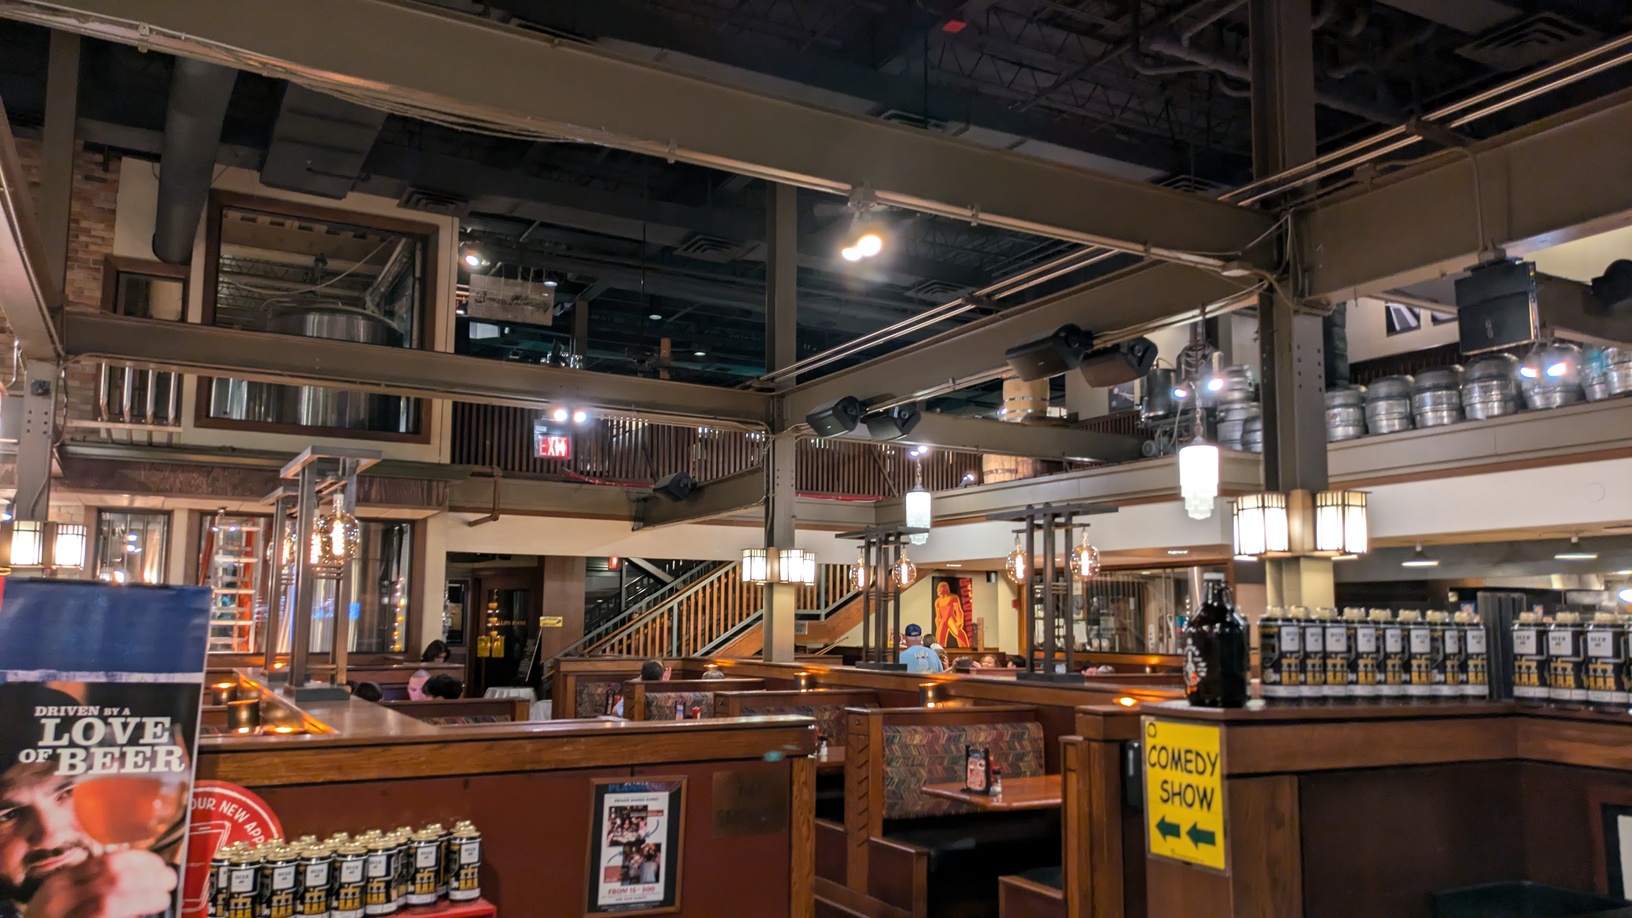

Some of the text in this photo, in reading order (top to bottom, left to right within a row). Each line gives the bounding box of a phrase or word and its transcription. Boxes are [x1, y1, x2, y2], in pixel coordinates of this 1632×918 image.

[538, 436, 567, 457] EXIT
[34, 706, 131, 716] DRIVEN BY A
[38, 717, 171, 746] LOVE
[18, 746, 186, 776] OF BEER
[1148, 745, 1219, 777] COMEDY
[1160, 779, 1215, 812] SHOW
[219, 800, 251, 823] NEW
[243, 821, 265, 845] APP
[608, 887, 628, 895] FROM
